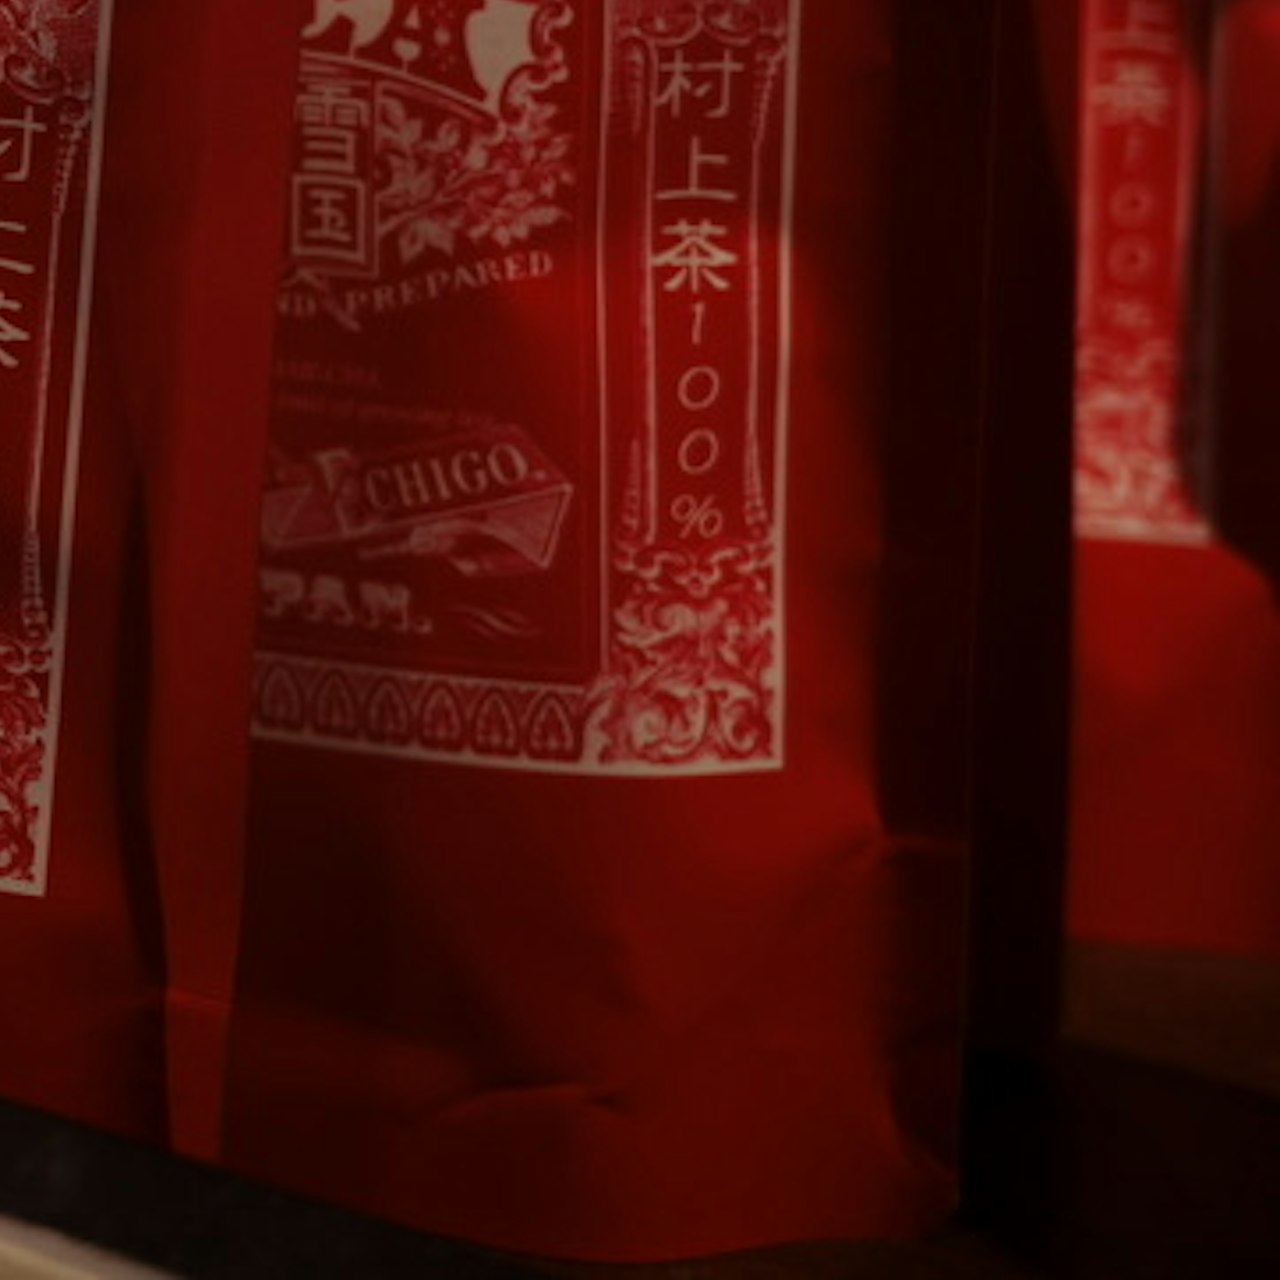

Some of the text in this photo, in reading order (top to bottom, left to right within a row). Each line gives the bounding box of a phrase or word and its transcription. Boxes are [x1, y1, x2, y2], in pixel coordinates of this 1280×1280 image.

[343, 249, 554, 319] PREPARED
[653, 48, 744, 541] 村上茶100%
